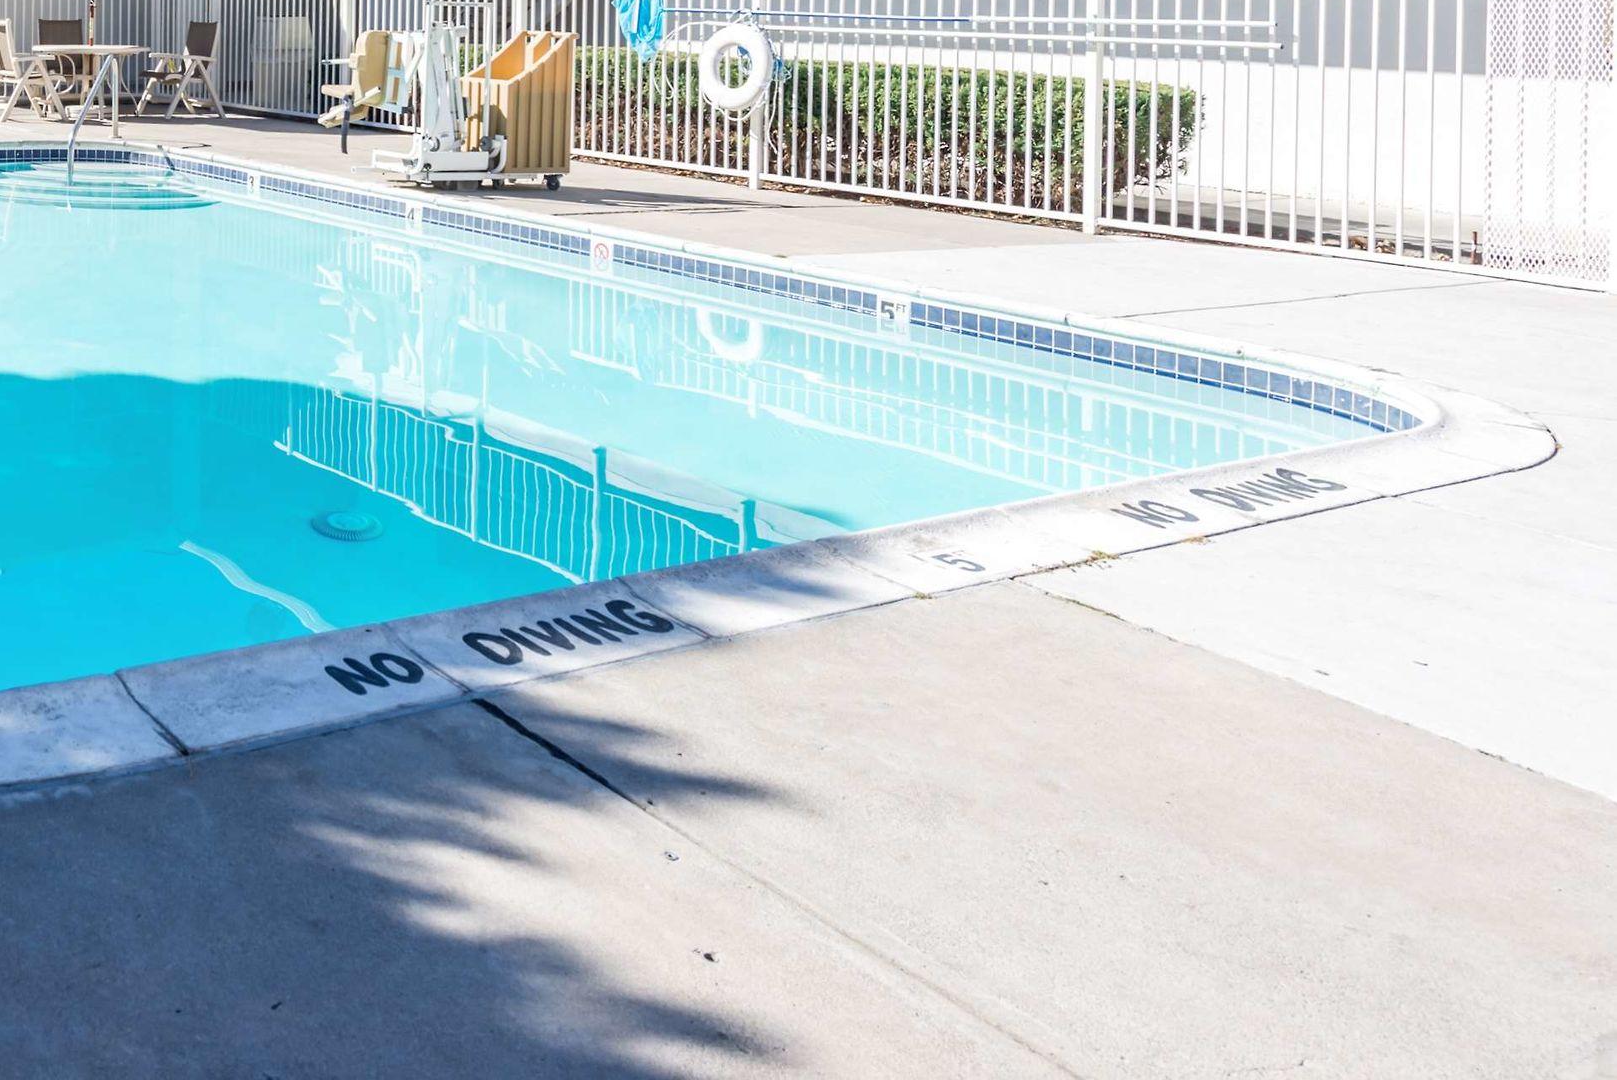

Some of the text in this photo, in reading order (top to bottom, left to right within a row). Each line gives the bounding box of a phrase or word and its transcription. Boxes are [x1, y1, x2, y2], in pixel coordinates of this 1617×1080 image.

[881, 300, 907, 320] 5 FT
[1109, 467, 1348, 529] NO DIVING
[931, 553, 986, 572] 5
[324, 599, 675, 696] NO DIVING
